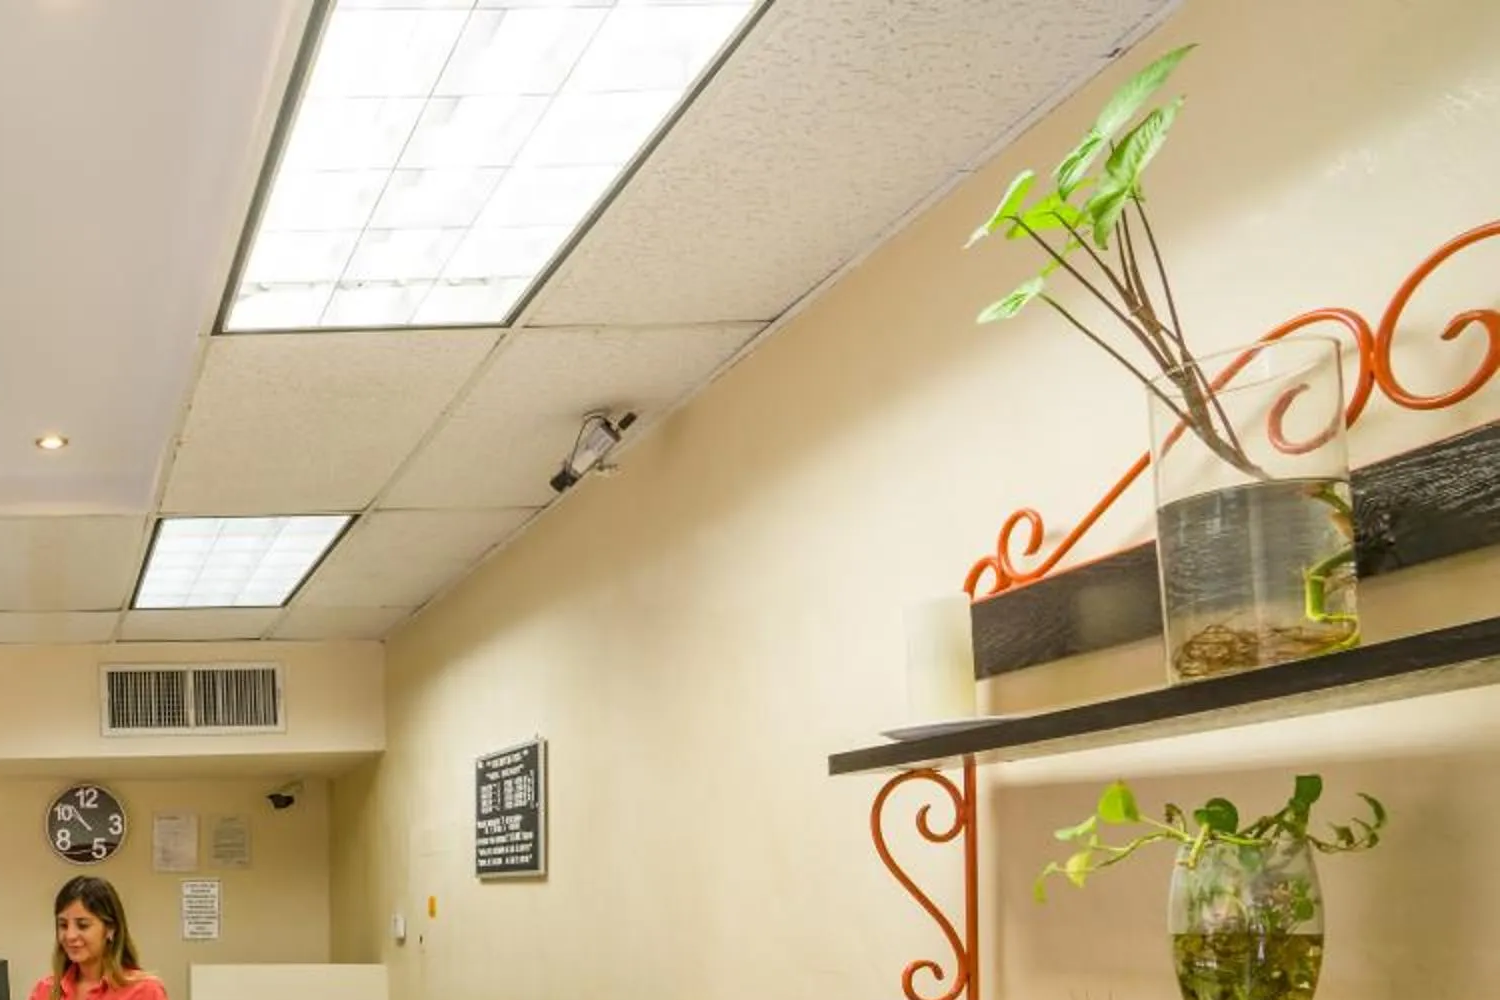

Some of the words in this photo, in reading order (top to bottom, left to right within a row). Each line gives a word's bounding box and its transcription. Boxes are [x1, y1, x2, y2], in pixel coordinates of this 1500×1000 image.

[75, 787, 99, 809] 12
[53, 803, 73, 821] 10
[108, 814, 123, 835] 3
[56, 828, 71, 851] 8
[91, 837, 107, 859] 5
